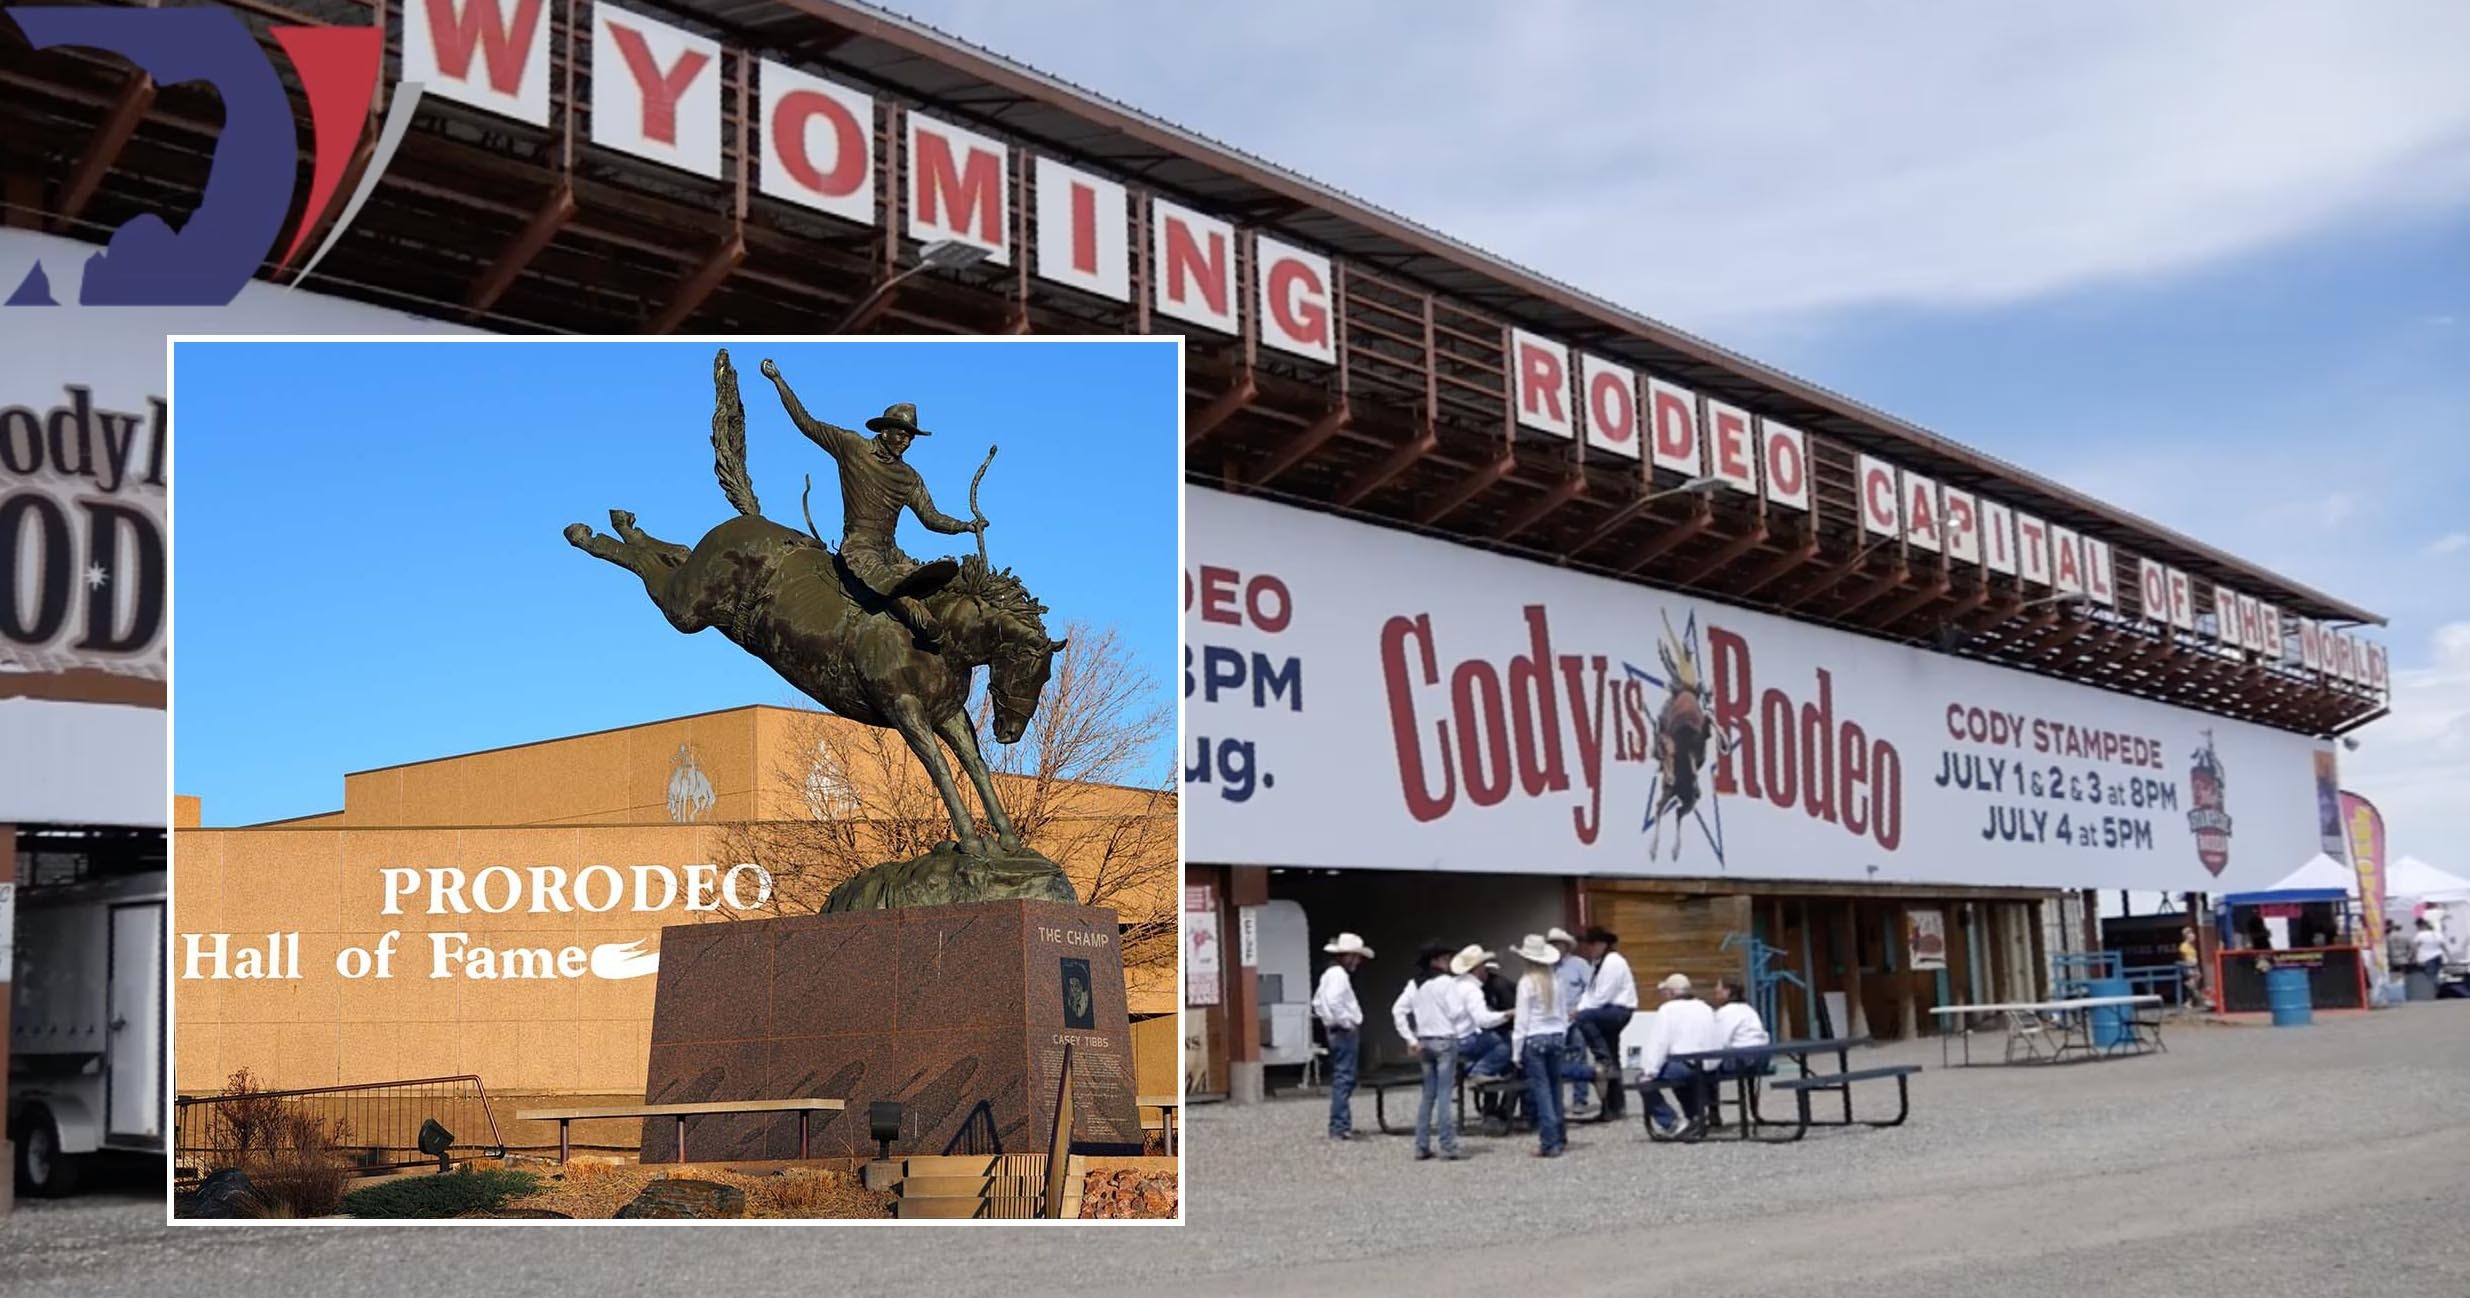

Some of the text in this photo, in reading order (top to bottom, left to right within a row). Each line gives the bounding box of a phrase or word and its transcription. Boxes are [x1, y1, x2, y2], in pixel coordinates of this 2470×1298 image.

[420, 0, 2386, 687] WYOMING RODEO CAPITAL OF THE WORLD
[1185, 564, 1292, 633] EO
[1380, 605, 1901, 851] Cody IS Rodeo
[1946, 703, 2164, 770] CODY STAMPEDE
[1934, 751, 2178, 811] JULY 1 & 2 & 3 at 8PM
[1982, 805, 2048, 843] JULY
[2055, 813, 2073, 845] 4
[2079, 822, 2098, 848] at
[2103, 816, 2154, 850] 5PM
[380, 862, 774, 916] PRORODEO
[180, 929, 588, 980] Hall of Fame
[1038, 927, 1109, 949] THE CHAMP
[1053, 1034, 1109, 1048] CASEY TIBBS
